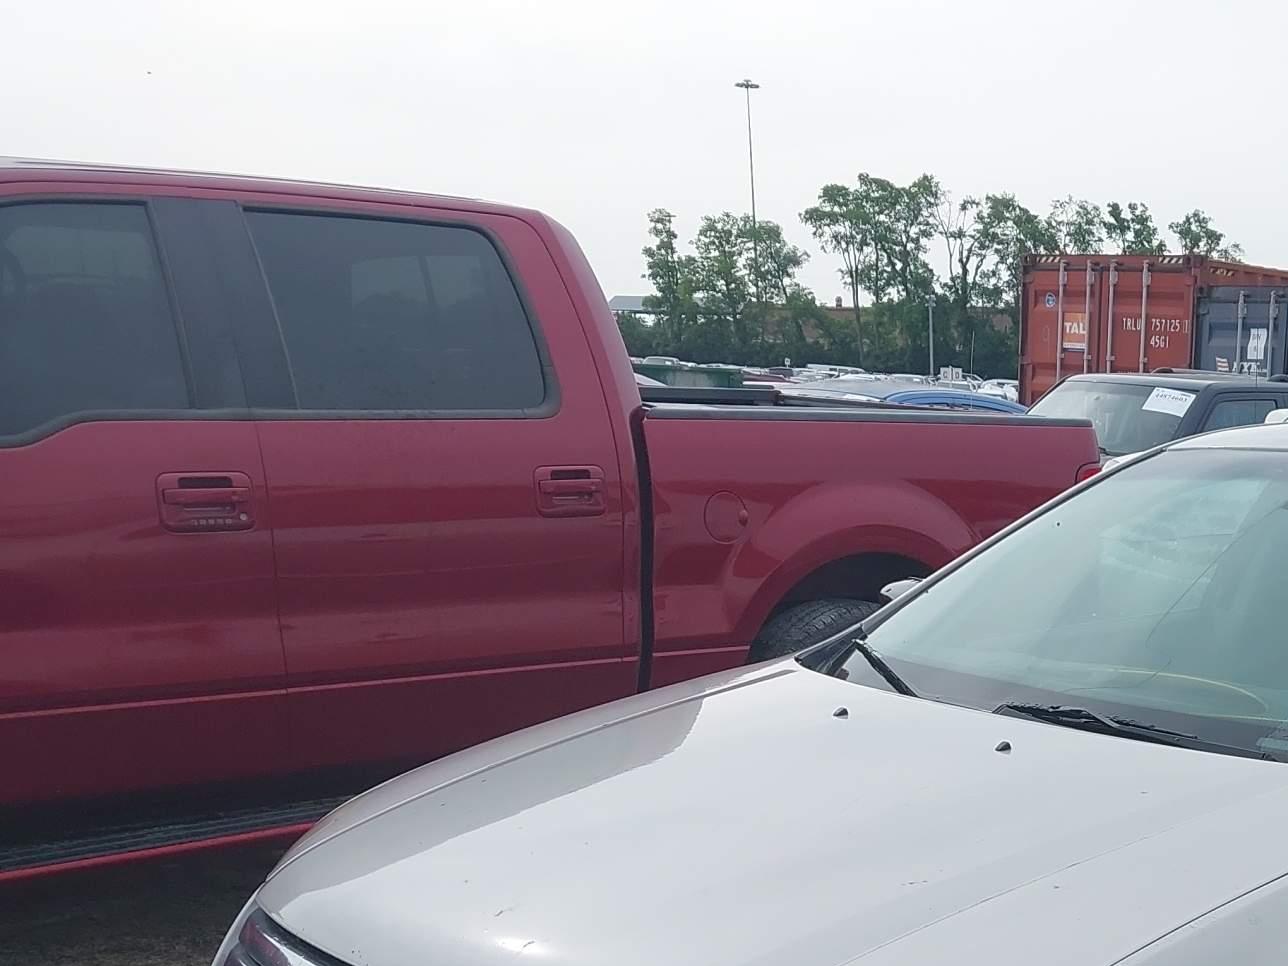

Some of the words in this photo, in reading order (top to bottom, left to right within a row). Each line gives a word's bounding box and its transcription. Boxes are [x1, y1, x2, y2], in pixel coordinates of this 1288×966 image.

[1063, 321, 1086, 334] TAL
[1122, 317, 1141, 331] TRLU
[1151, 318, 1180, 332] 757125
[1149, 335, 1169, 348] 45G1
